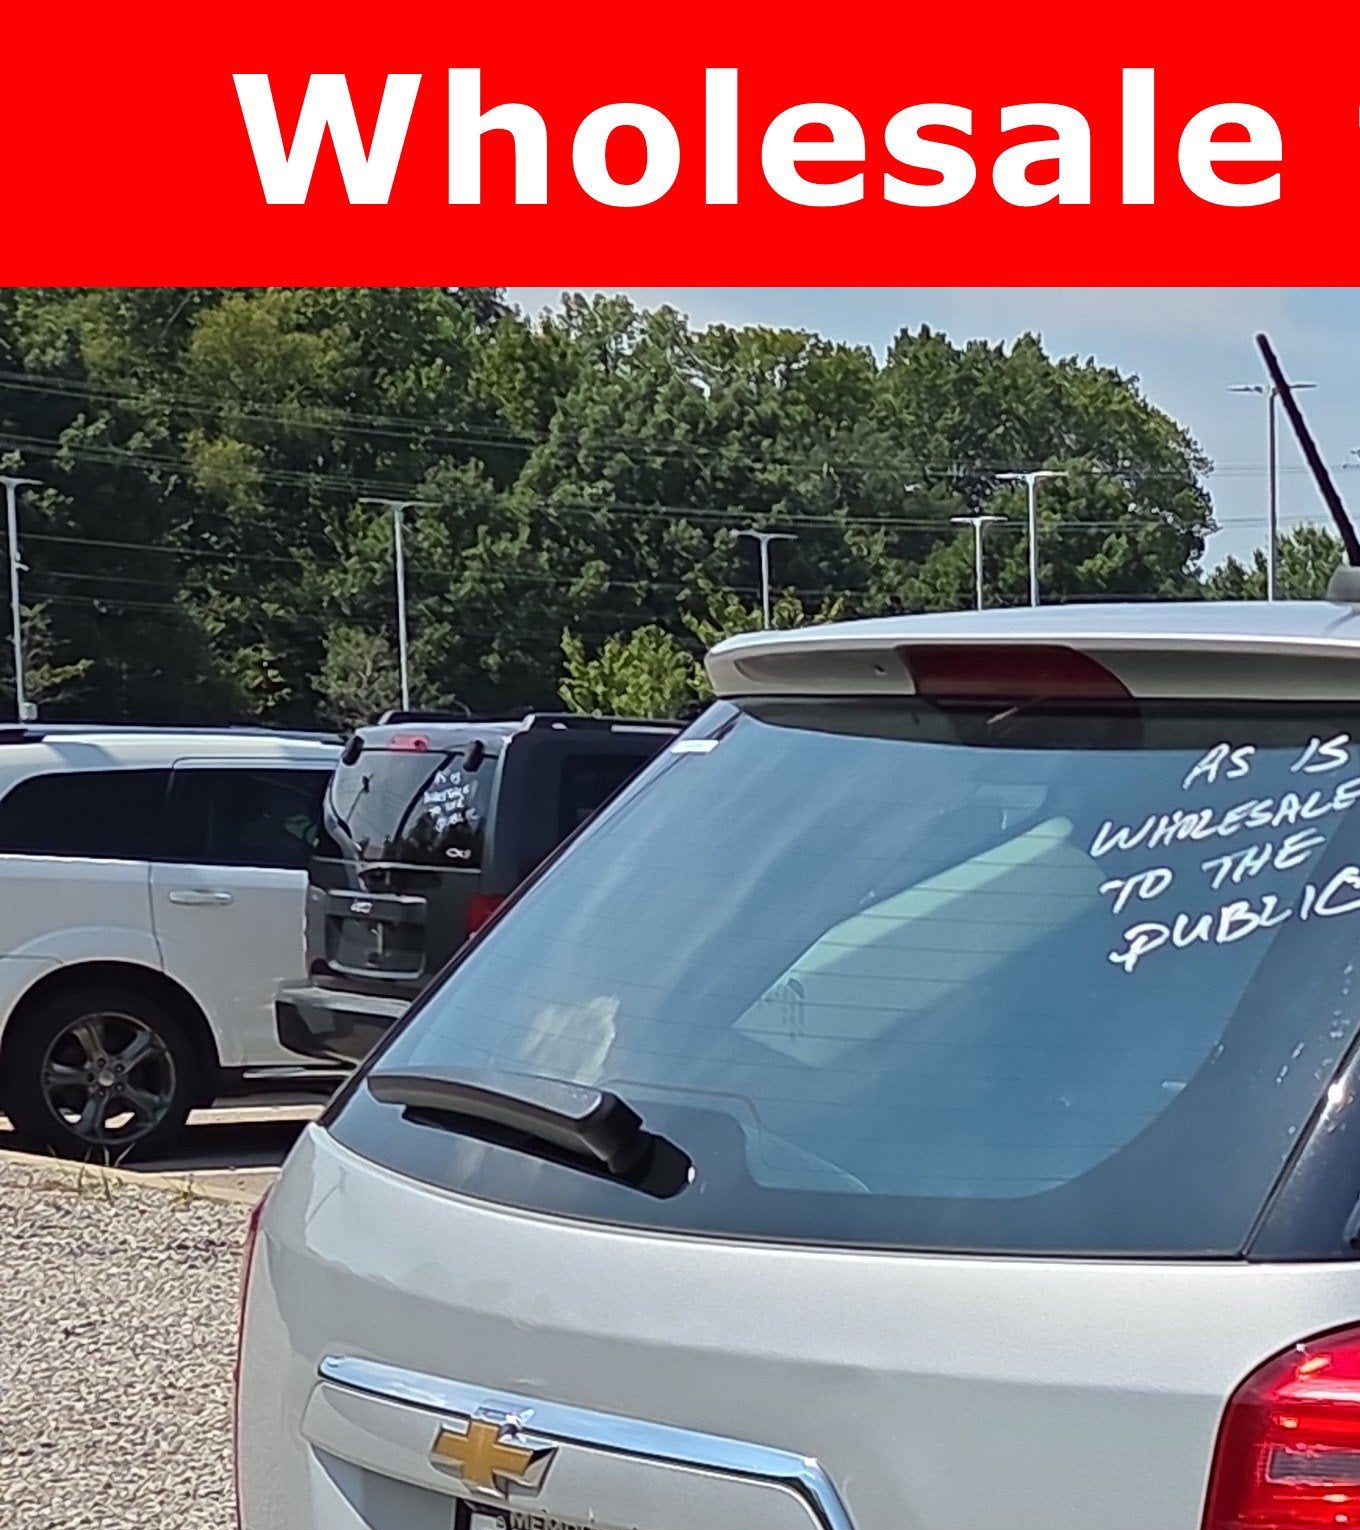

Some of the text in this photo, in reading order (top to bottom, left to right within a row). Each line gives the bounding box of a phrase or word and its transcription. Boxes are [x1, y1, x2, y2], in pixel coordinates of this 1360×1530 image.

[1183, 734, 1349, 789] AS IS
[1100, 827, 1325, 914] TO THE
